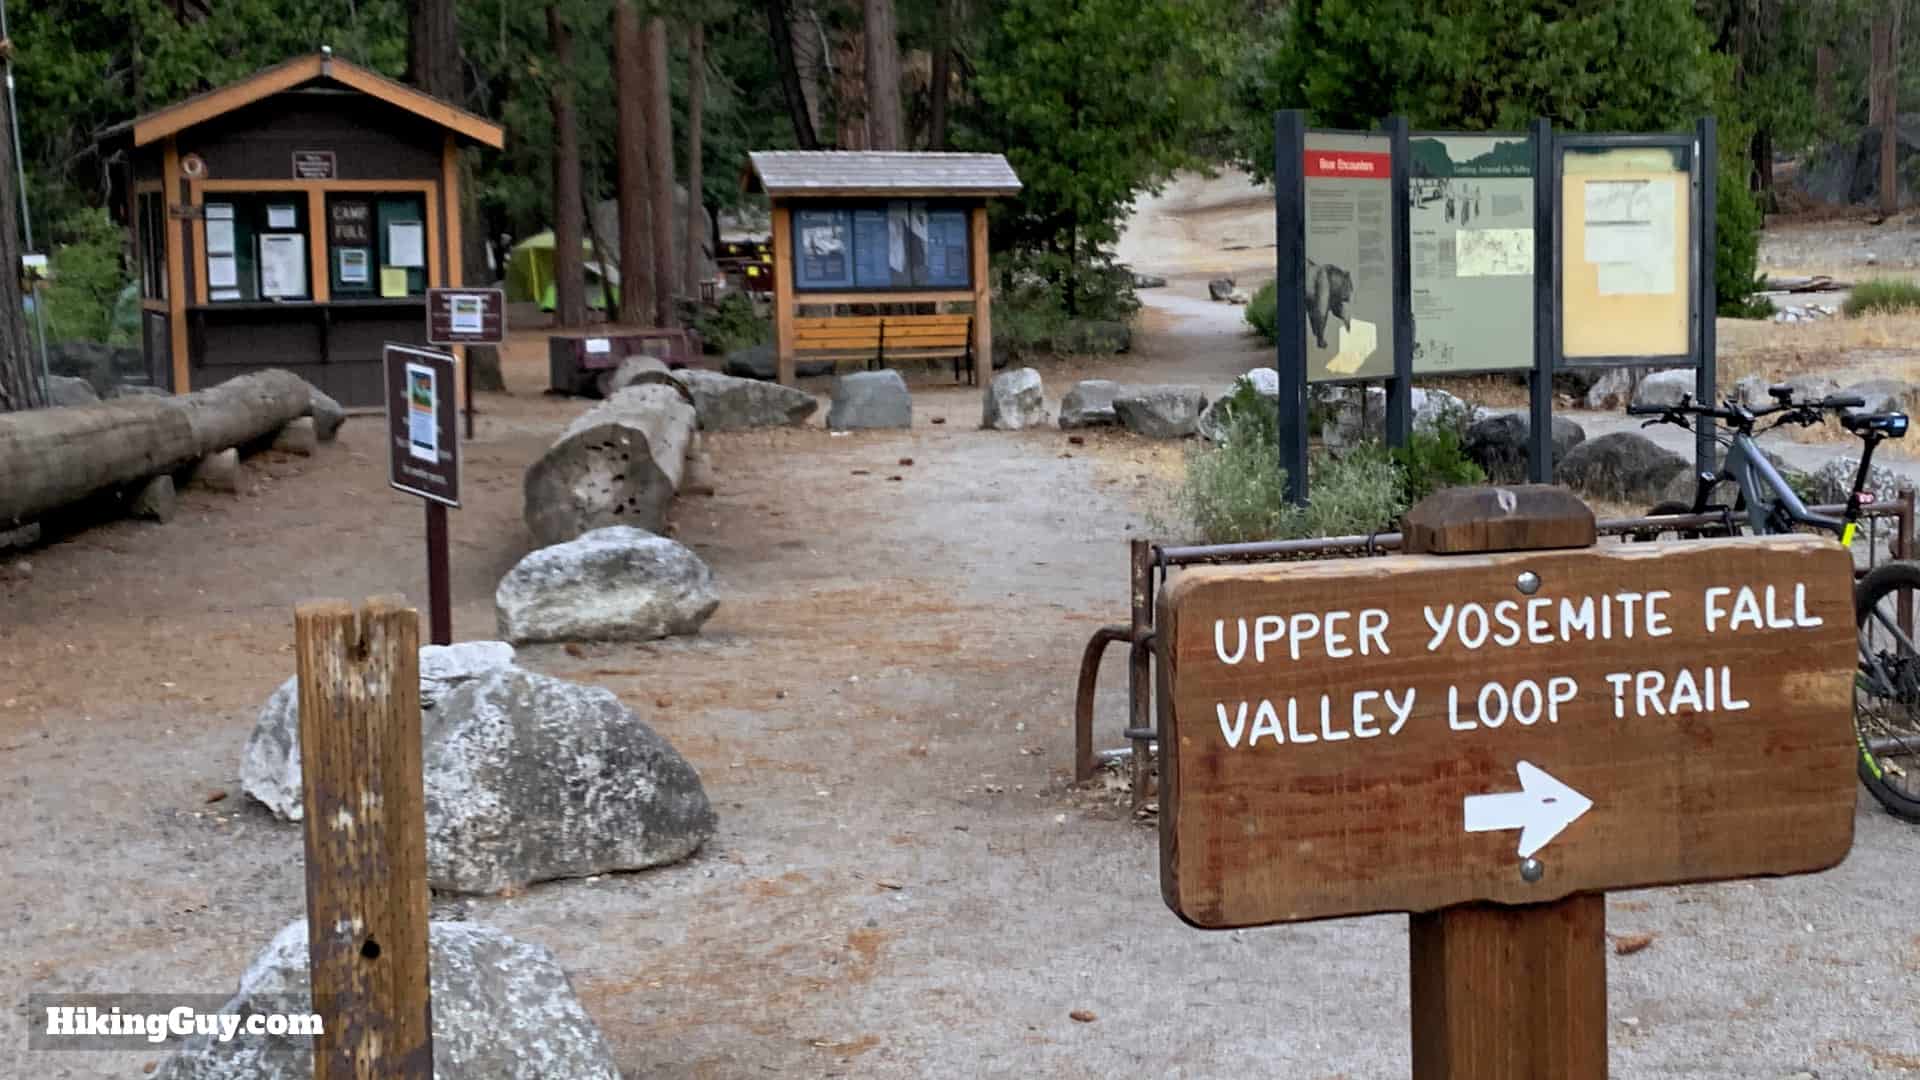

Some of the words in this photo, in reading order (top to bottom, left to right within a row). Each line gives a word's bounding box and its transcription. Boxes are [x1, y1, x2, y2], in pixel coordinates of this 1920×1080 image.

[332, 206, 367, 219] CAMP
[335, 224, 367, 239] FULL
[1214, 608, 1390, 665] UPPER
[1423, 590, 1673, 651] YOSEMITE
[1704, 582, 1823, 632] FALL
[1216, 687, 1416, 749] VALLEY
[1448, 676, 1579, 731] LOOP
[1605, 665, 1750, 719] TRAIL
